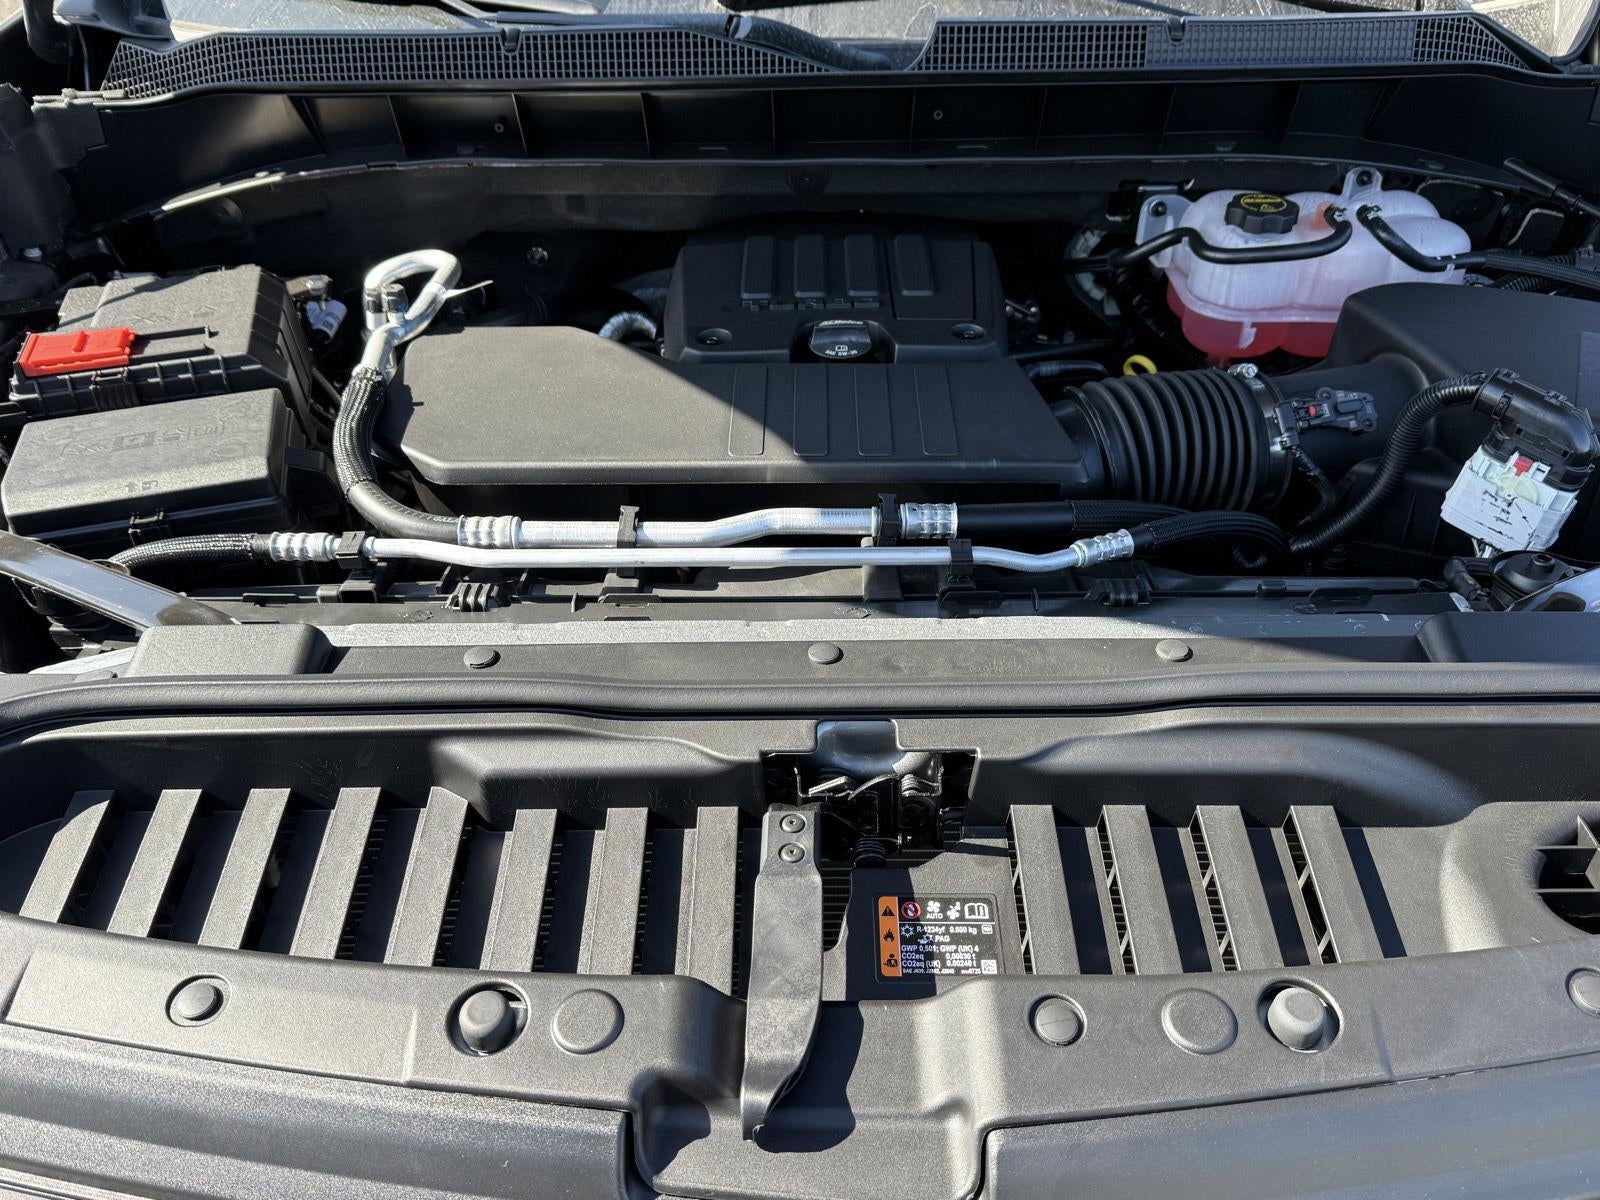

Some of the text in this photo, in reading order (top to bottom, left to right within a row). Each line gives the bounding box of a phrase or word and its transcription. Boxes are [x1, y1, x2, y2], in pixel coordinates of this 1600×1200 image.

[916, 926, 946, 934] R-1234yf
[968, 926, 978, 934] kg
[957, 945, 973, 953] (UK)
[902, 960, 925, 968] CO2eq
[925, 960, 941, 968] (UK)
